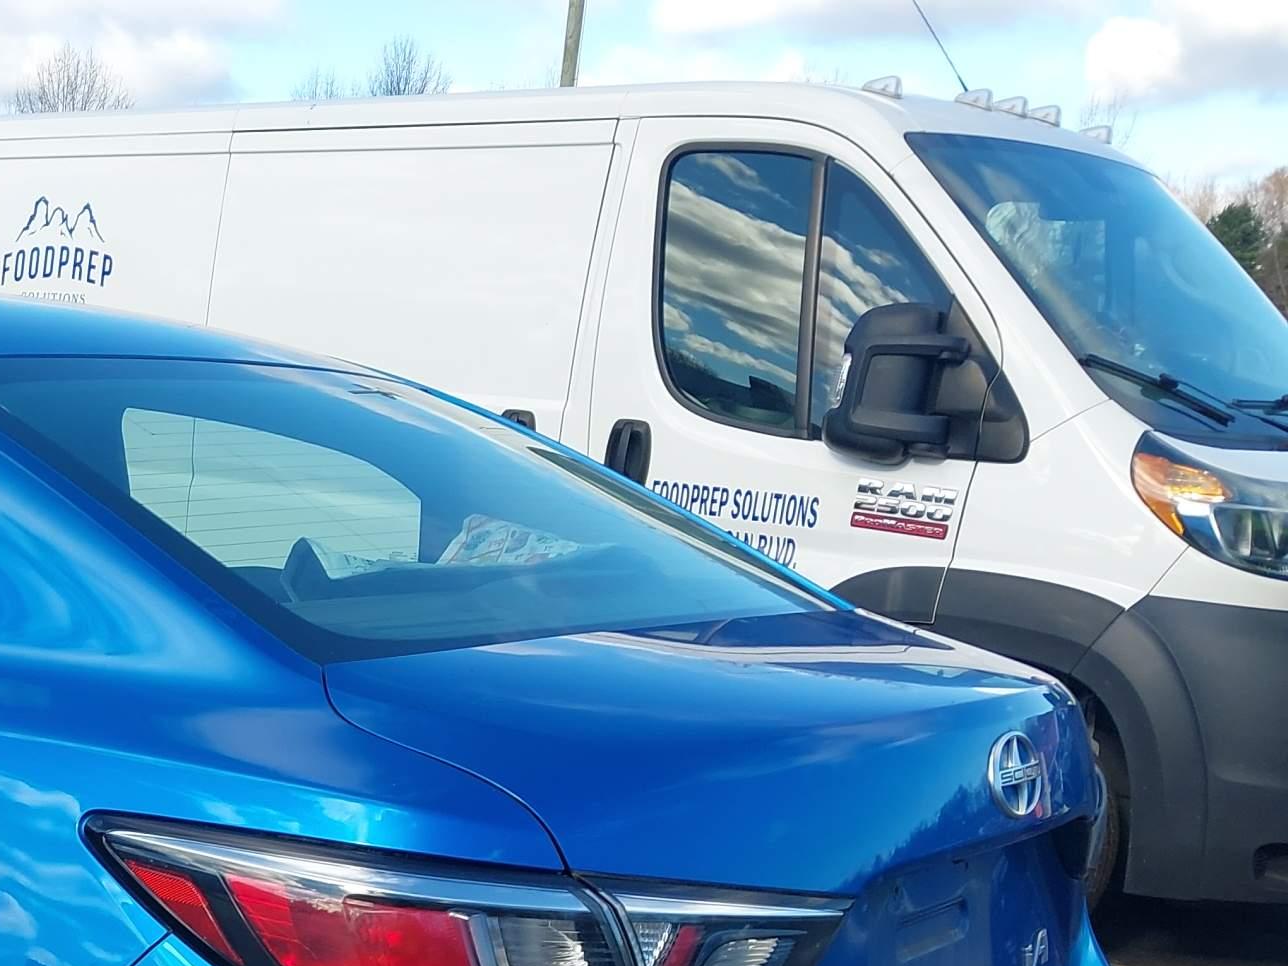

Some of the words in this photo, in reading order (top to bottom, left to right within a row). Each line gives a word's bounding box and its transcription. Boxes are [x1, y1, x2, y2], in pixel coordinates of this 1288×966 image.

[1, 245, 113, 287] FOODPREP
[731, 488, 820, 528] SOLUTIONS
[854, 494, 953, 522] 2500
[856, 478, 959, 506] RAM
